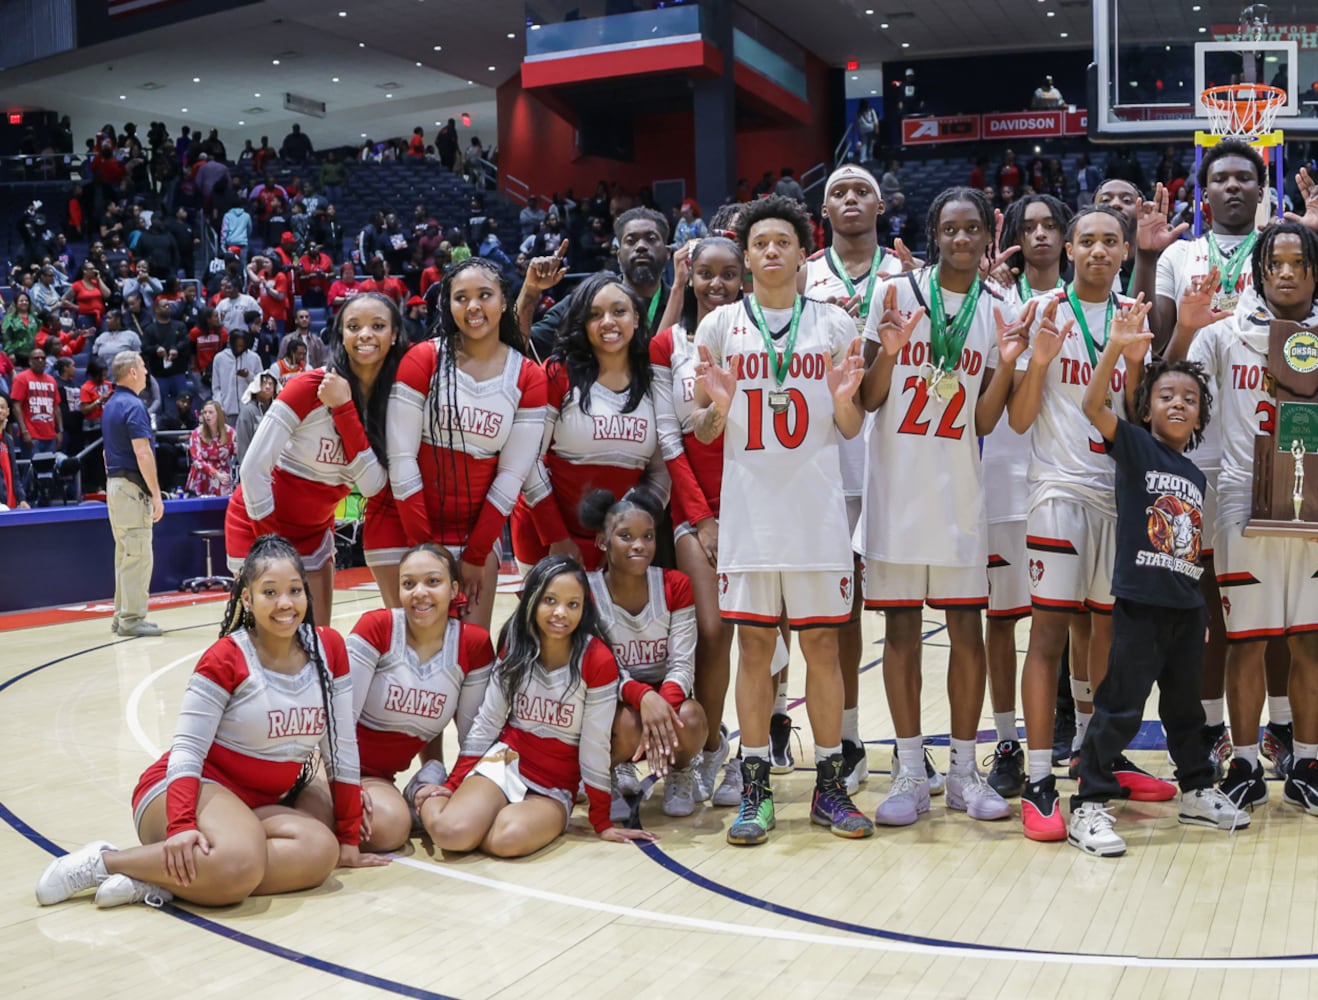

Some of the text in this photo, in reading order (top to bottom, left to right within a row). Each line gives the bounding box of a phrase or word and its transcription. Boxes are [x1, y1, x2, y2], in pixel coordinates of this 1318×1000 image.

[990, 118, 1055, 134] DAVIDSON
[726, 352, 825, 380] ROTOOD
[1290, 346, 1318, 358] OHSAA
[441, 405, 503, 439] RAMS
[742, 388, 809, 451] 10
[897, 375, 966, 440] 22
[593, 415, 648, 443] RAMS
[316, 437, 349, 465] RA
[1136, 549, 1174, 571] STATE
[613, 638, 668, 667] RAMS
[384, 684, 447, 720] RAMS
[515, 692, 576, 728] RAMS
[267, 706, 327, 739] RAMS
